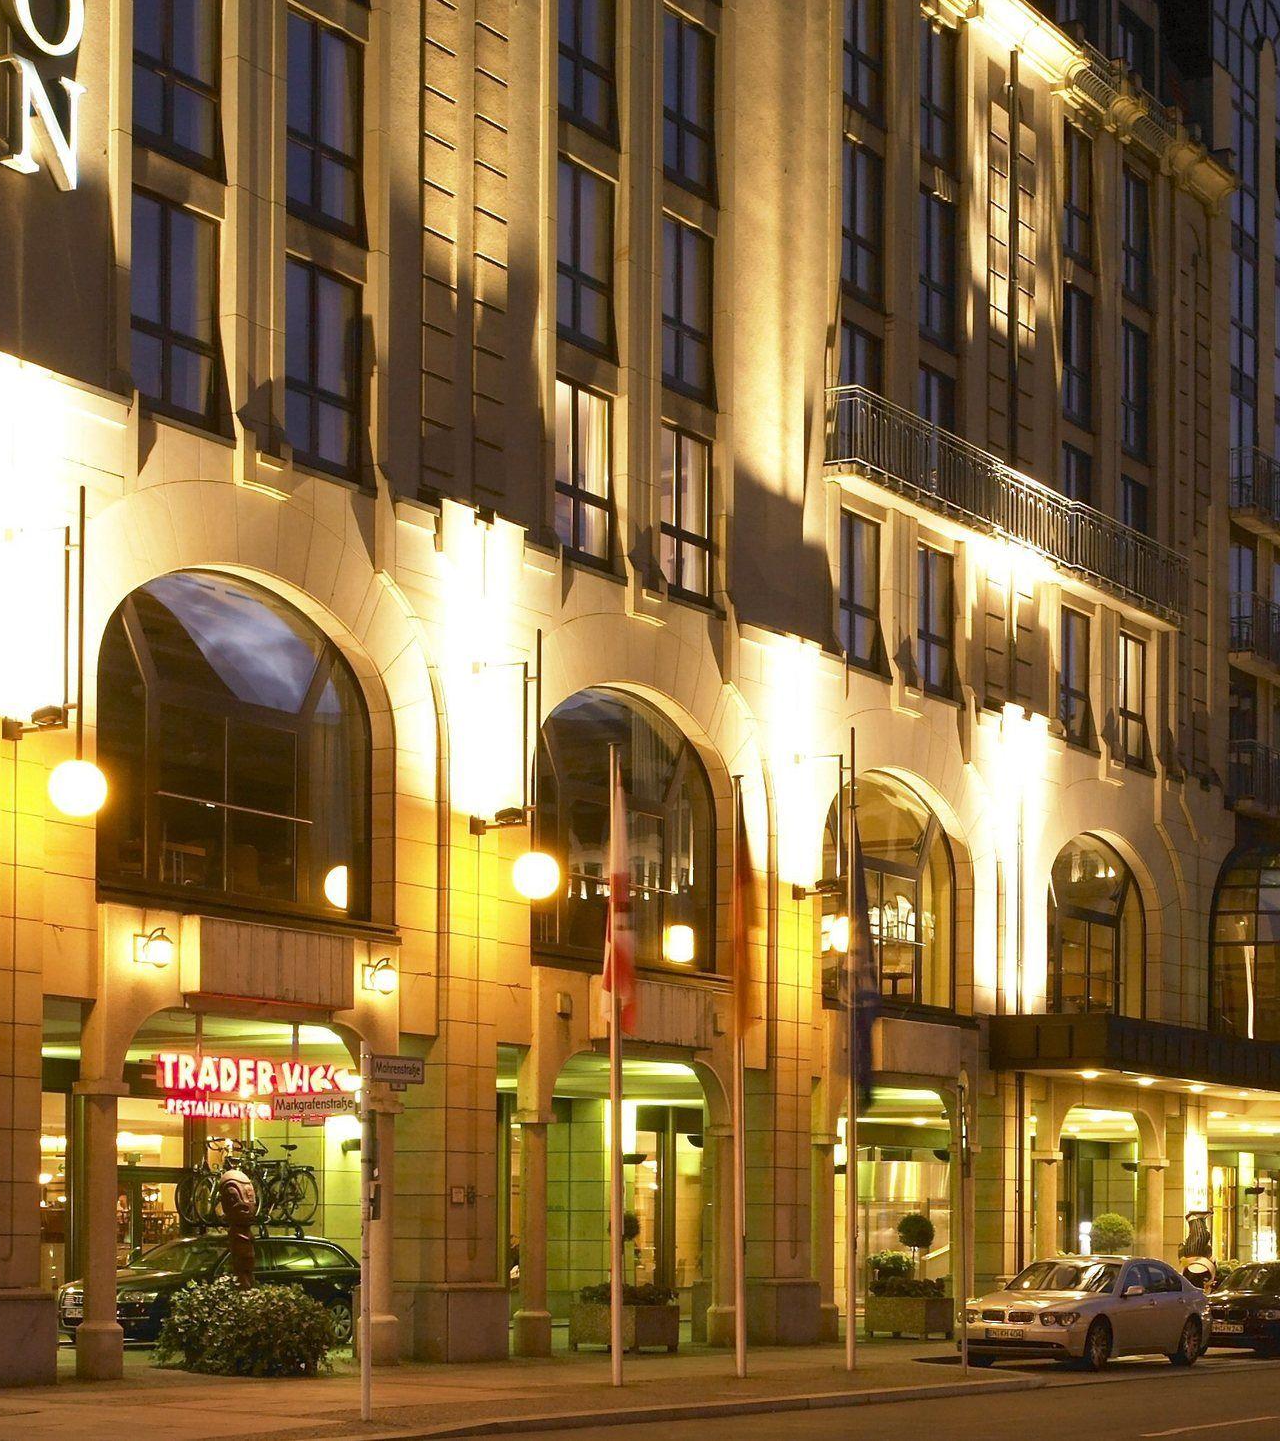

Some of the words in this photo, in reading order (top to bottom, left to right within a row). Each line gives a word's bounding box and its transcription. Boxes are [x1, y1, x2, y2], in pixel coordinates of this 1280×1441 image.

[160, 1053, 275, 1095] TRADER
[375, 1061, 421, 1077] Mohrenstraße
[166, 1099, 248, 1118] RESTAURANT
[275, 1096, 354, 1113] Markgrafenstraße
